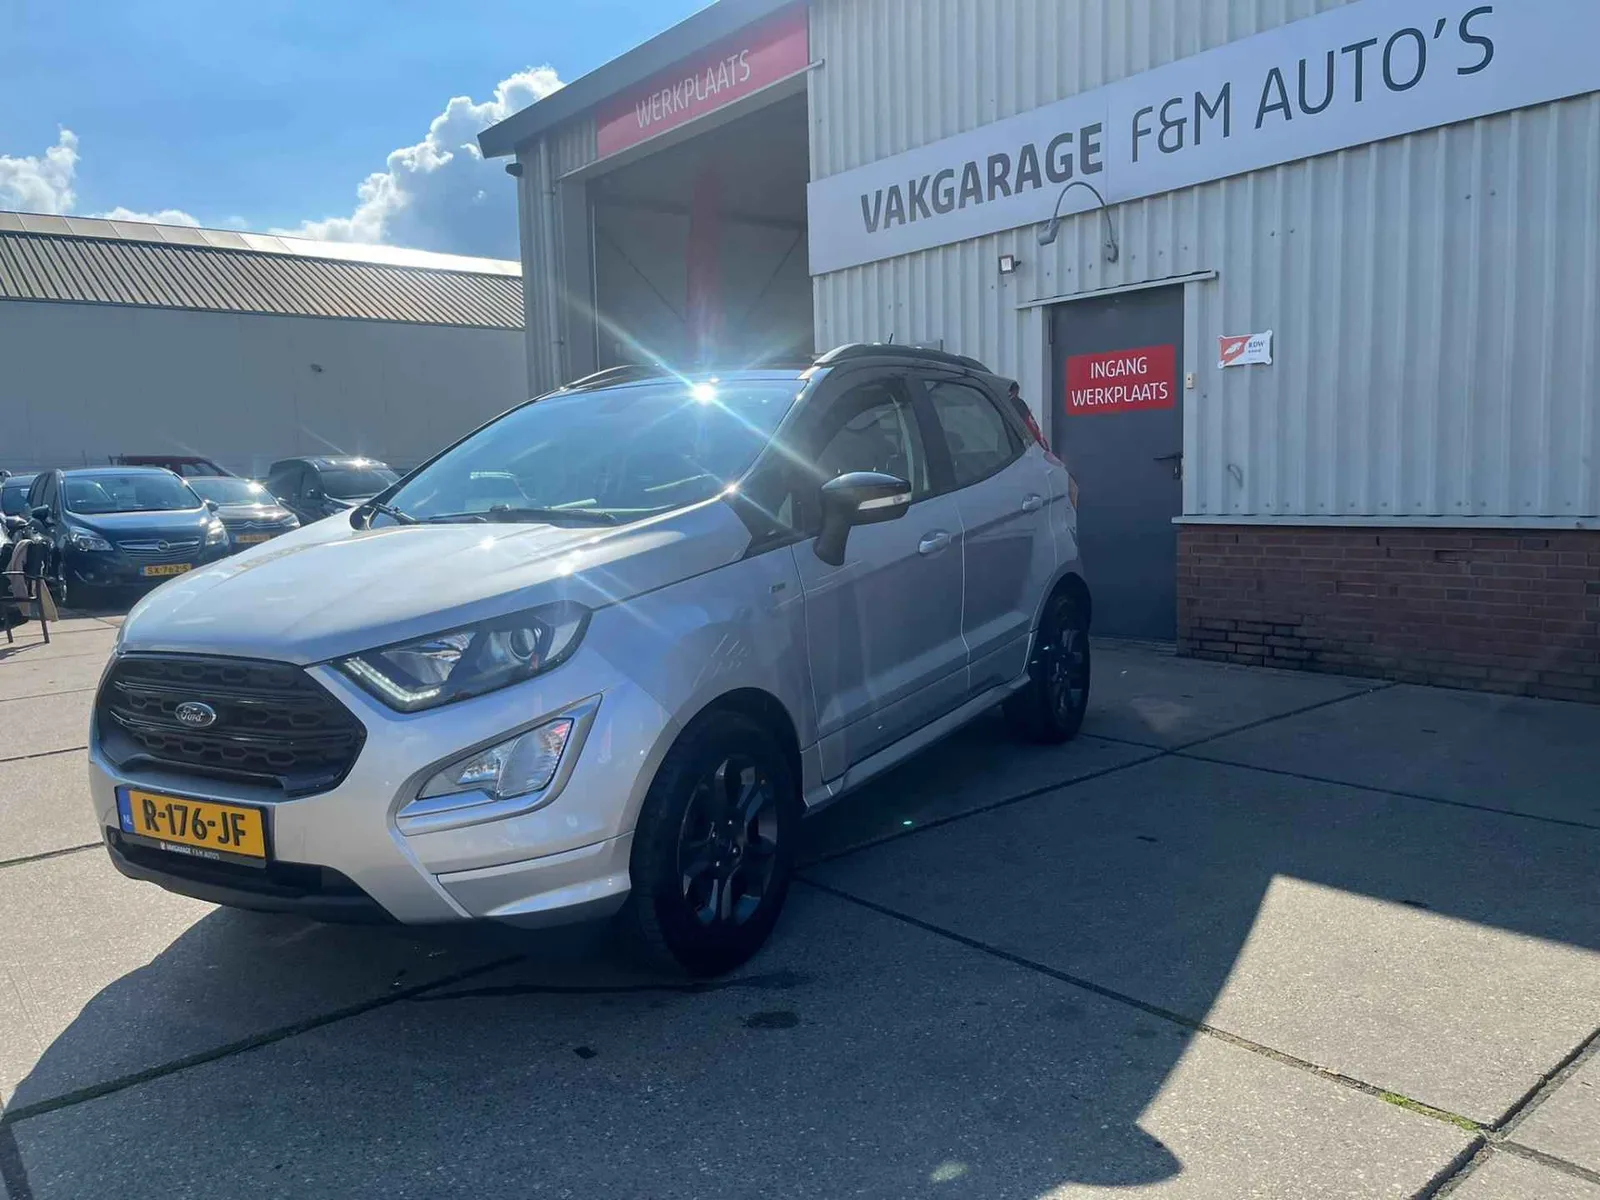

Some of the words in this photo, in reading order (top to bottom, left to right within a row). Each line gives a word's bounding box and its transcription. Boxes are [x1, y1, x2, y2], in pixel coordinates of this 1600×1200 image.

[635, 49, 751, 129] WERKPLAATS
[861, 122, 1103, 234] VAKGARAGE
[1131, 82, 1231, 163] F&M
[1254, 5, 1495, 129] AUTO'S
[1090, 356, 1148, 379] INGANG
[1071, 381, 1168, 407] WERKPLAATS
[180, 705, 205, 722] Ford
[123, 814, 132, 825] NL
[142, 798, 246, 847] R-176-JF
